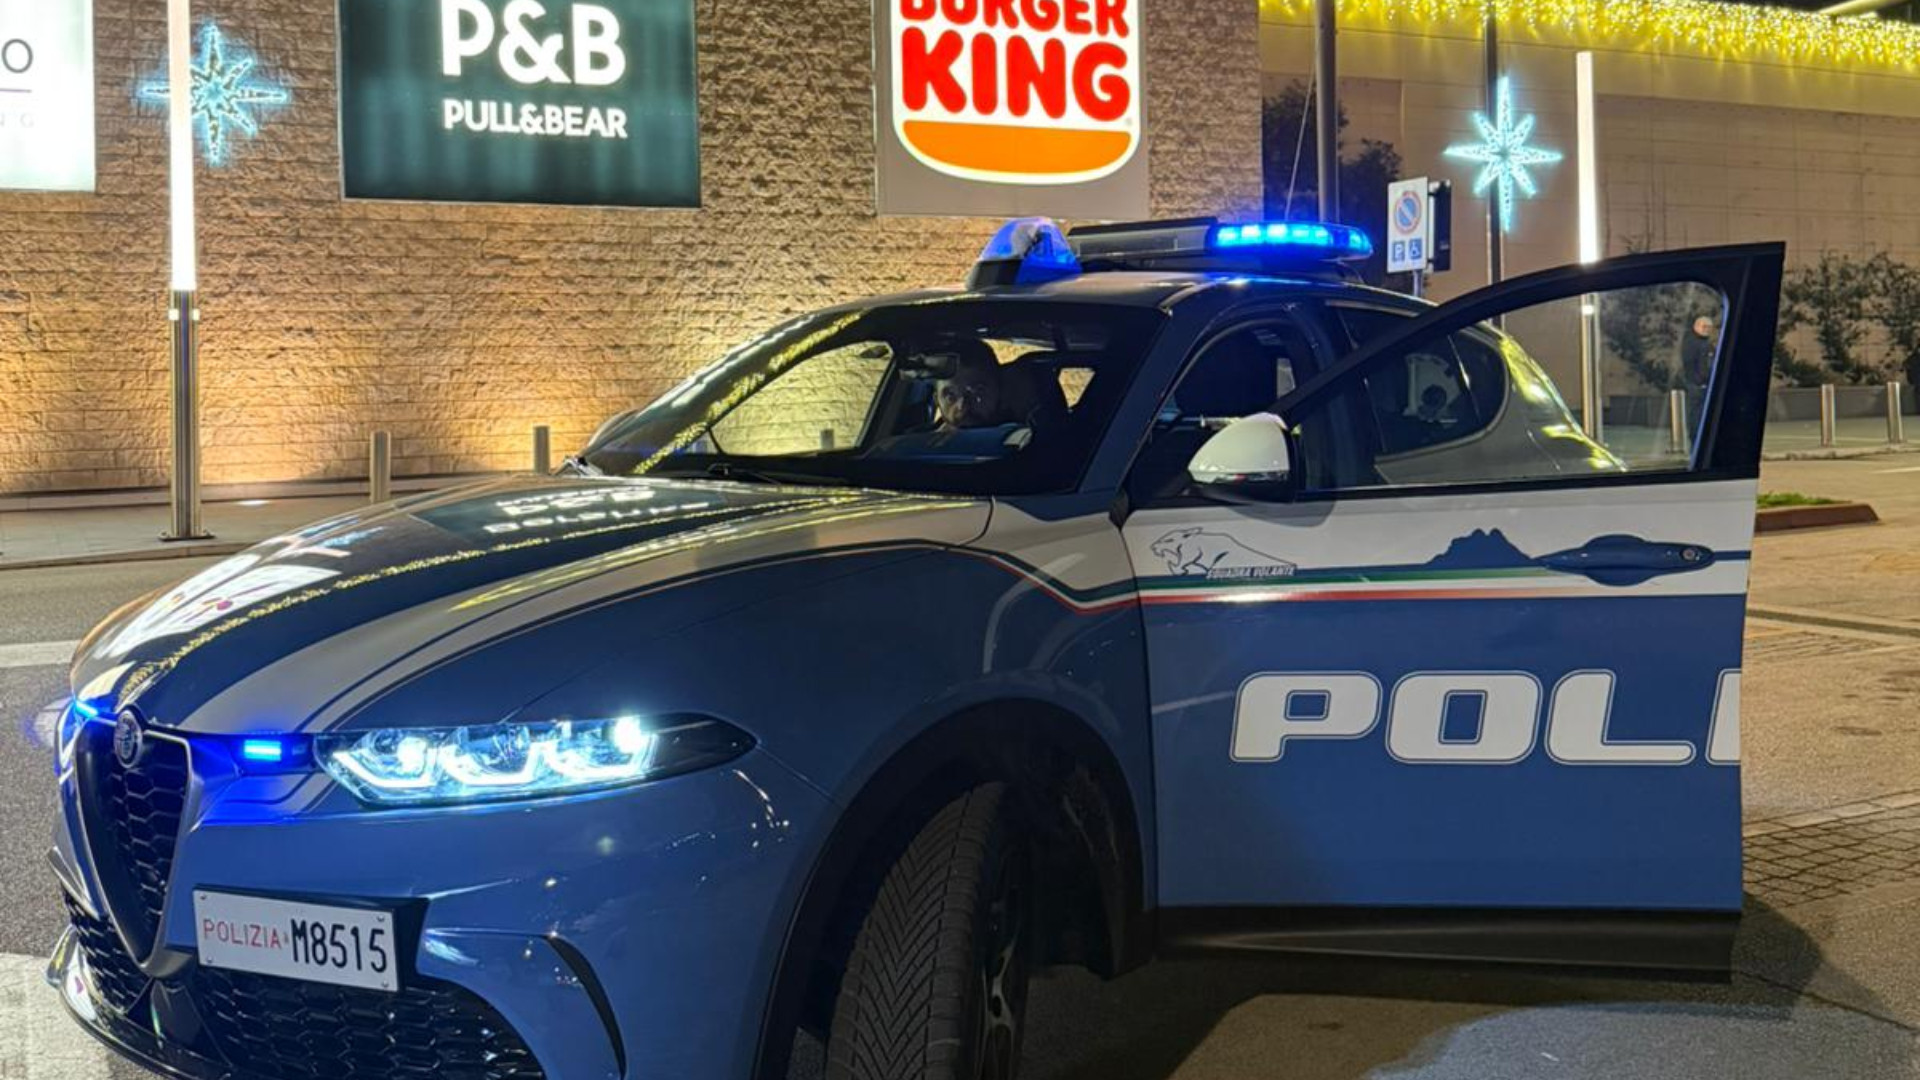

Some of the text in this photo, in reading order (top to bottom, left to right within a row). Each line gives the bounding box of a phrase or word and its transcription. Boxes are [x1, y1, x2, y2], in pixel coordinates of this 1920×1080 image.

[441, 0, 626, 86] P&B
[901, 27, 1131, 122] KING
[443, 98, 628, 139] PULL&BEAR
[1230, 668, 1741, 766] POLI
[203, 918, 388, 973] POLIZIA M8515
